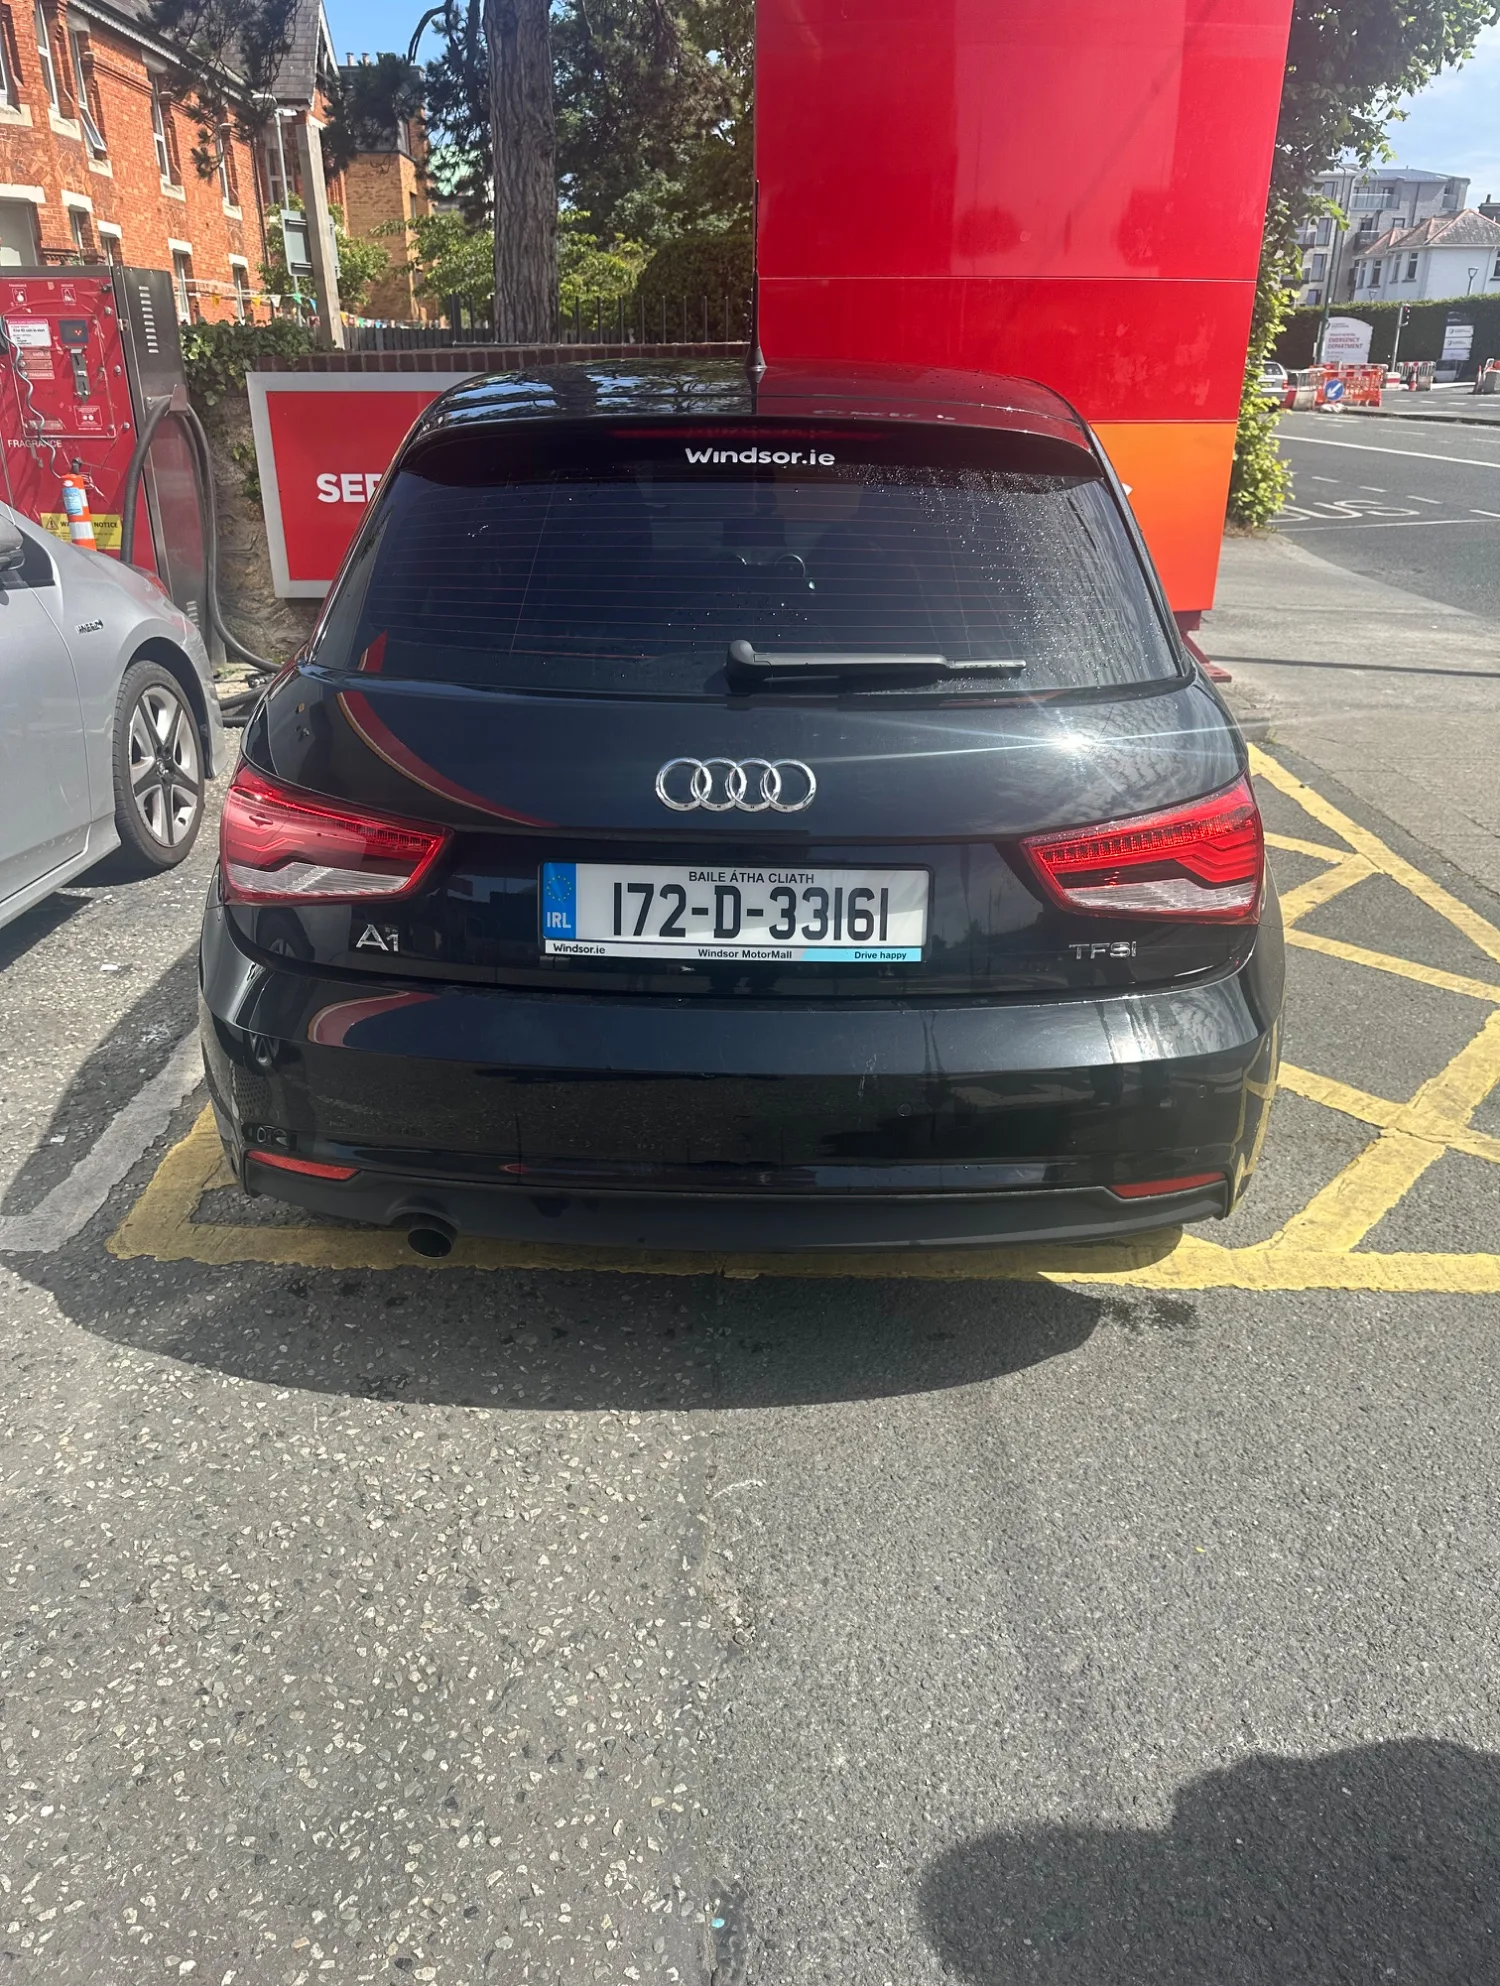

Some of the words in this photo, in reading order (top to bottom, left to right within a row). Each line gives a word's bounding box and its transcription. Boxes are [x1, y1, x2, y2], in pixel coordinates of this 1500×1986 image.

[685, 447, 835, 466] Windsor.ie
[94, 521, 118, 529] NOTICE
[689, 871, 726, 882] BAILE
[729, 870, 765, 883] ÁTHA
[768, 872, 815, 884] CLIATH
[613, 882, 889, 941] 172-D-33161
[546, 911, 572, 929] IRL
[355, 923, 399, 952] A1
[553, 943, 606, 954] Windsor.ie
[698, 948, 739, 958] Windsor
[742, 950, 792, 959] MotorMall
[854, 951, 878, 959] Drive
[880, 951, 907, 960] happy
[1068, 941, 1137, 960] TFSI
